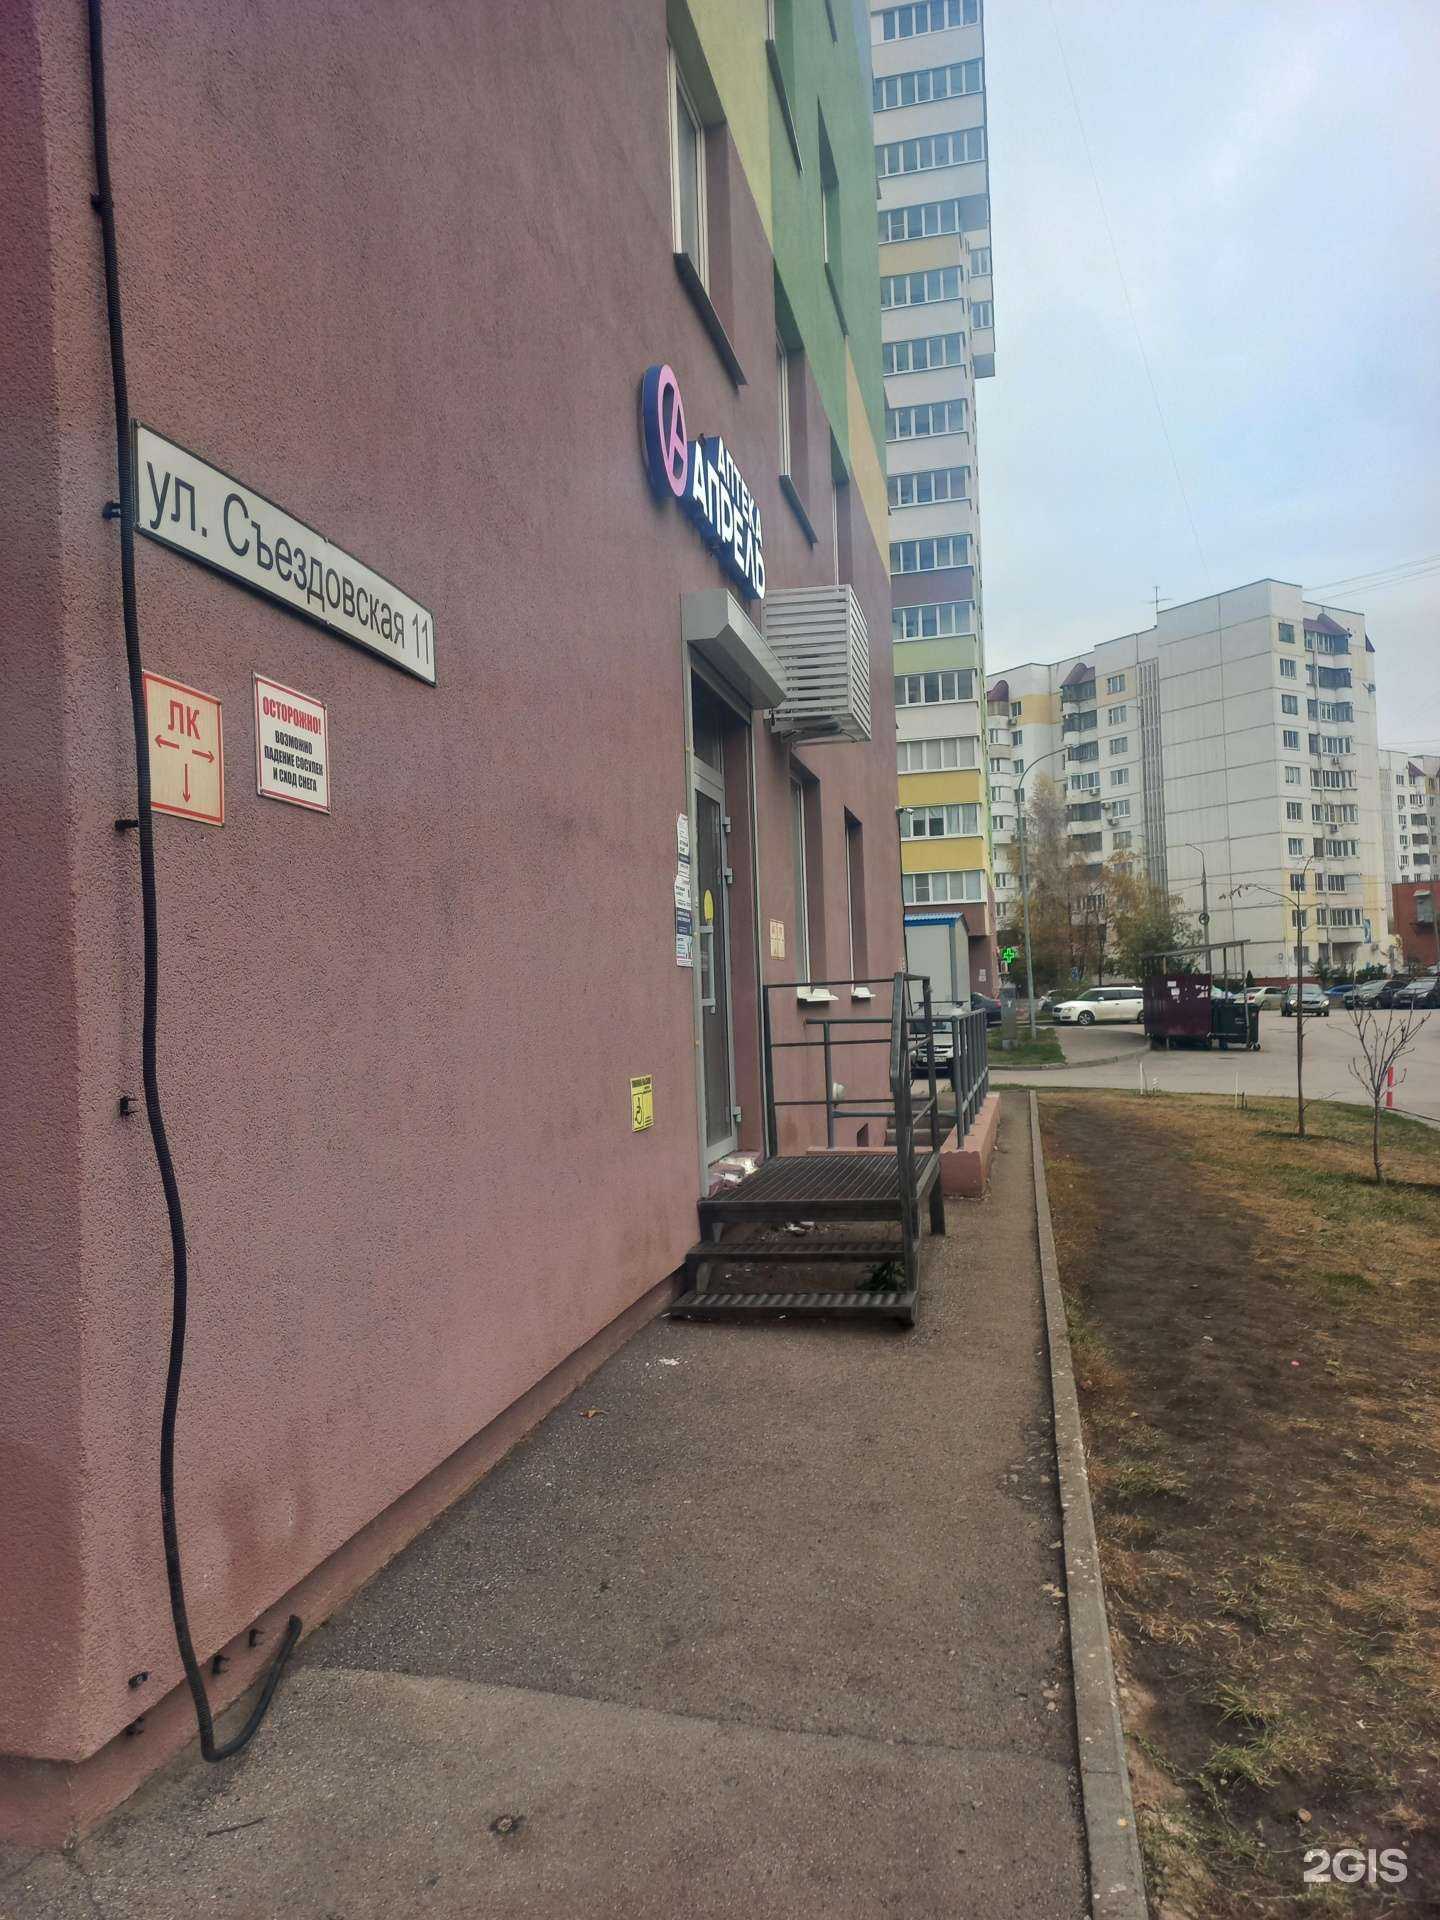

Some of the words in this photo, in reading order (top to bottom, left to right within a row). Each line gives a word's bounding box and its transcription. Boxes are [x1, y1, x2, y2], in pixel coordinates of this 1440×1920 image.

[717, 436, 763, 548] АПТЕКА
[692, 440, 766, 599] АПРЕЛЬ
[146, 461, 207, 538] ул.
[223, 493, 405, 649] Съездовская
[412, 613, 429, 665] 11
[167, 700, 200, 740] ЛК
[263, 696, 322, 735] ОСТОРОЖНО!
[264, 745, 295, 768] ПАДЕНИЕ
[295, 755, 324, 776] СОСУЛЕК
[274, 730, 313, 754] ВОЗМОЖНО
[272, 766, 279, 780] И
[278, 769, 298, 788] СХОД
[297, 774, 318, 792] СНЕГА
